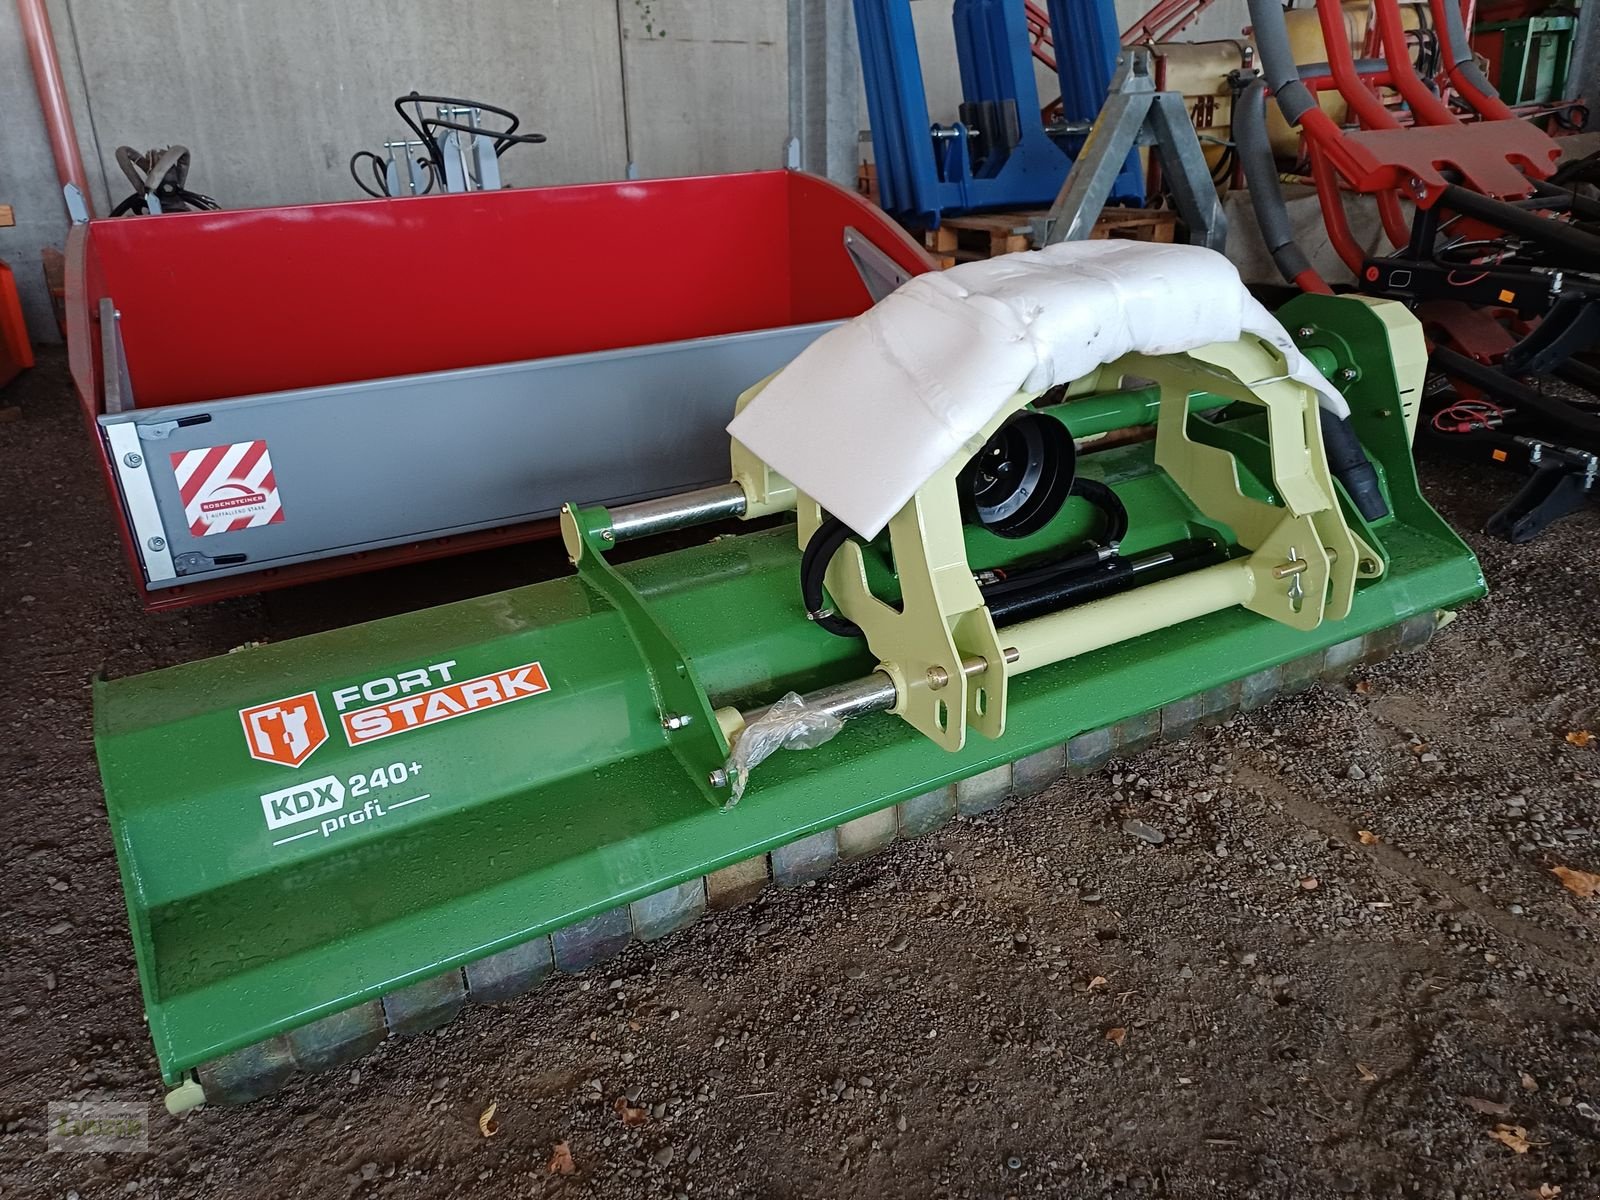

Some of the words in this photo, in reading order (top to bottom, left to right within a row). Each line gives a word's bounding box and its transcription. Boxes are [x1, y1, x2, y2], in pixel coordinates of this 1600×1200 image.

[203, 496, 264, 510] ROSENSTEINER
[332, 660, 457, 711] FORT
[350, 667, 543, 739] STARK
[270, 782, 340, 821] KDX
[348, 761, 423, 798] 240+
[321, 799, 387, 838] profi
